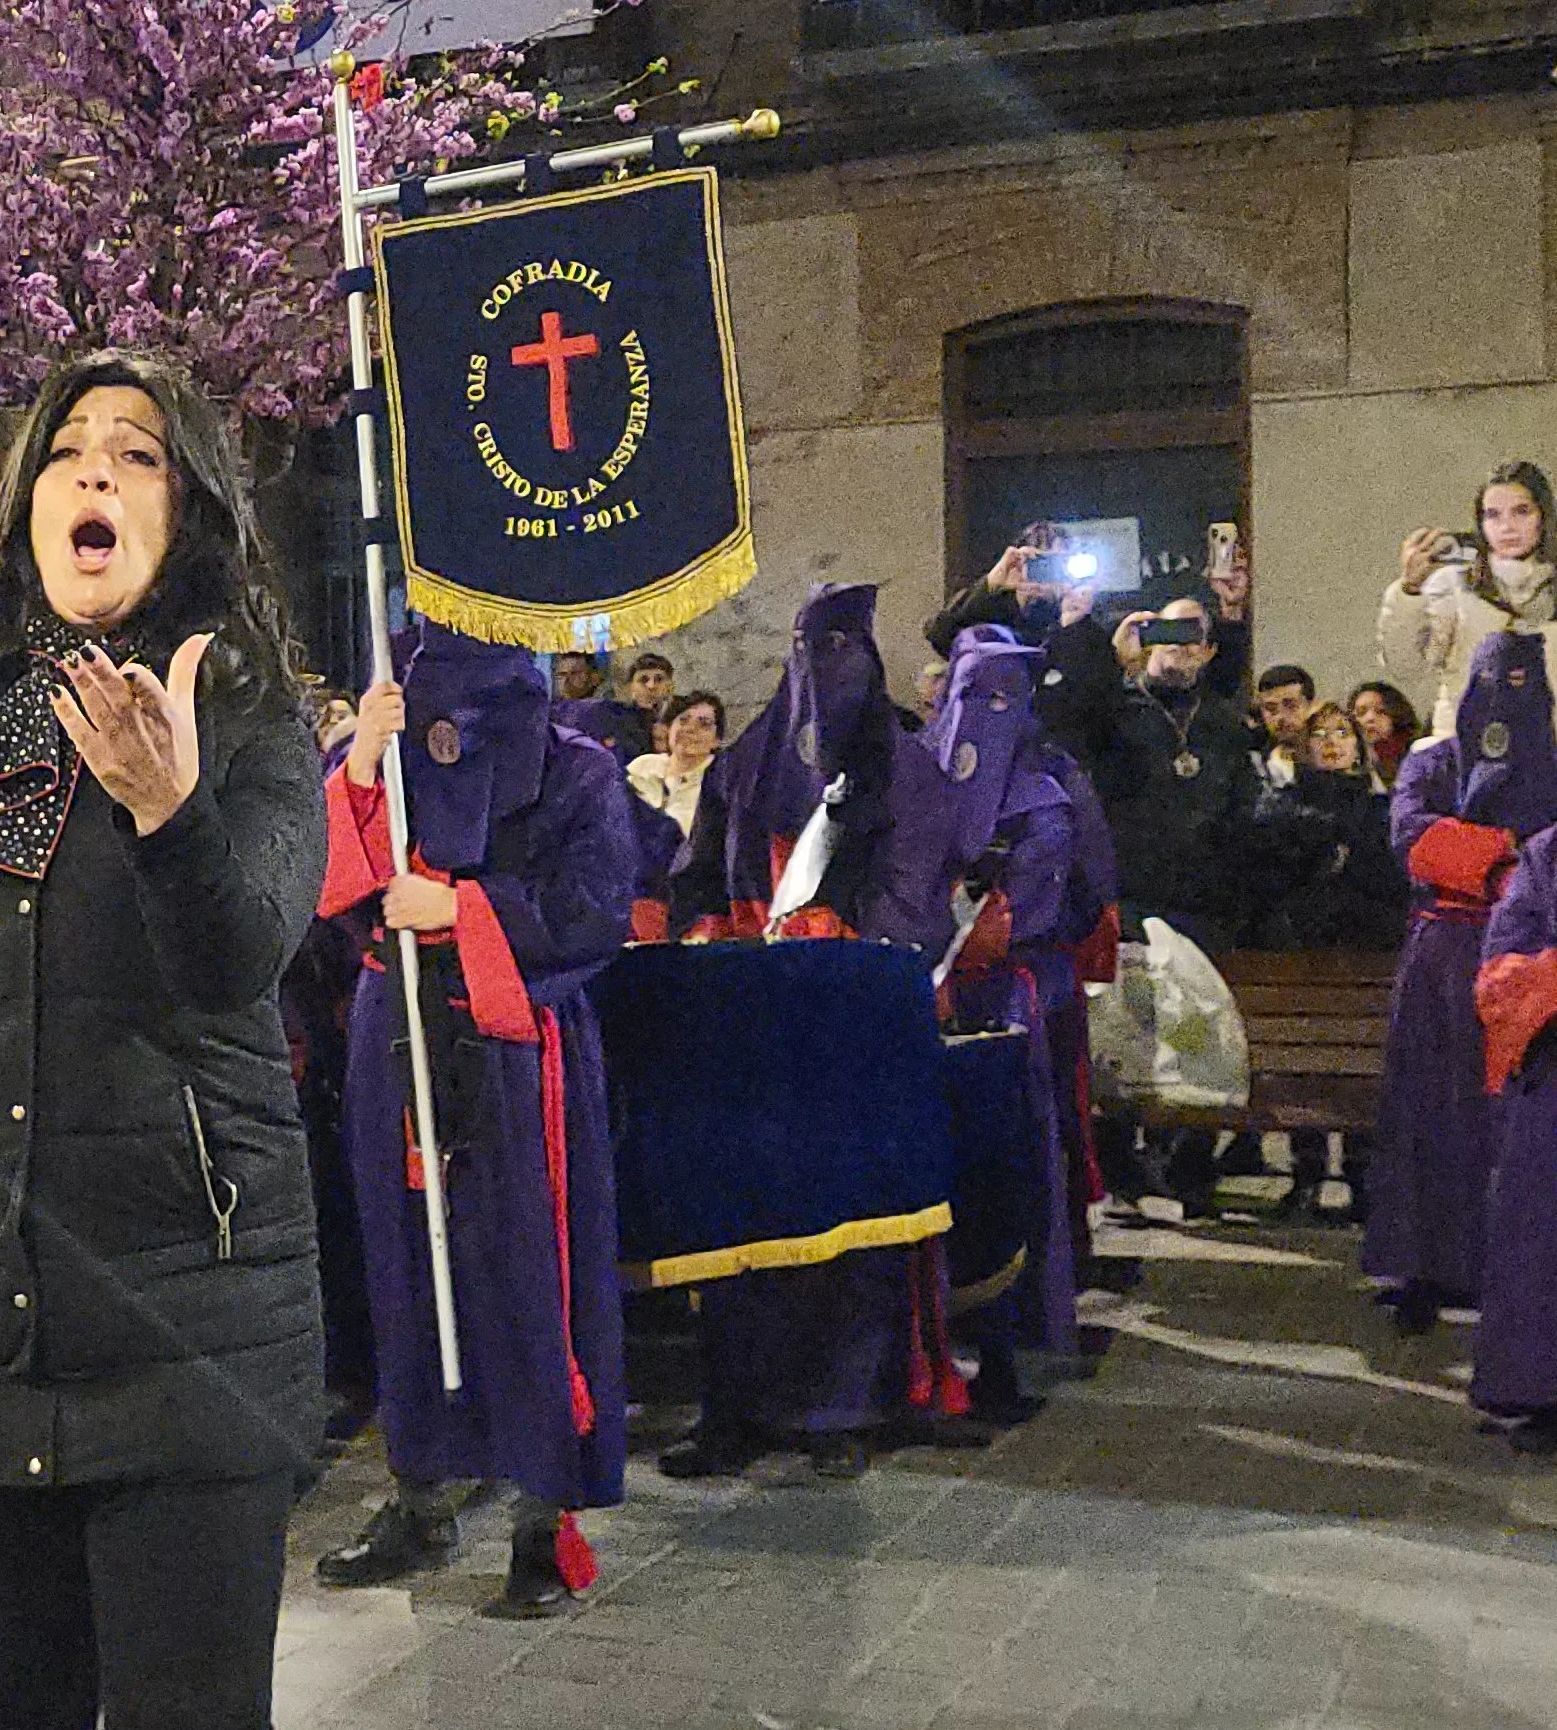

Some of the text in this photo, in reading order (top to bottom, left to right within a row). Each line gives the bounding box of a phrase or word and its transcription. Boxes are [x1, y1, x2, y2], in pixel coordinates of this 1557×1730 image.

[481, 258, 612, 320] COFRADIA
[467, 329, 650, 509] STO. CRISTO DE LA ESPERANZA
[504, 516, 558, 537] 1961
[582, 500, 641, 533] 2011
